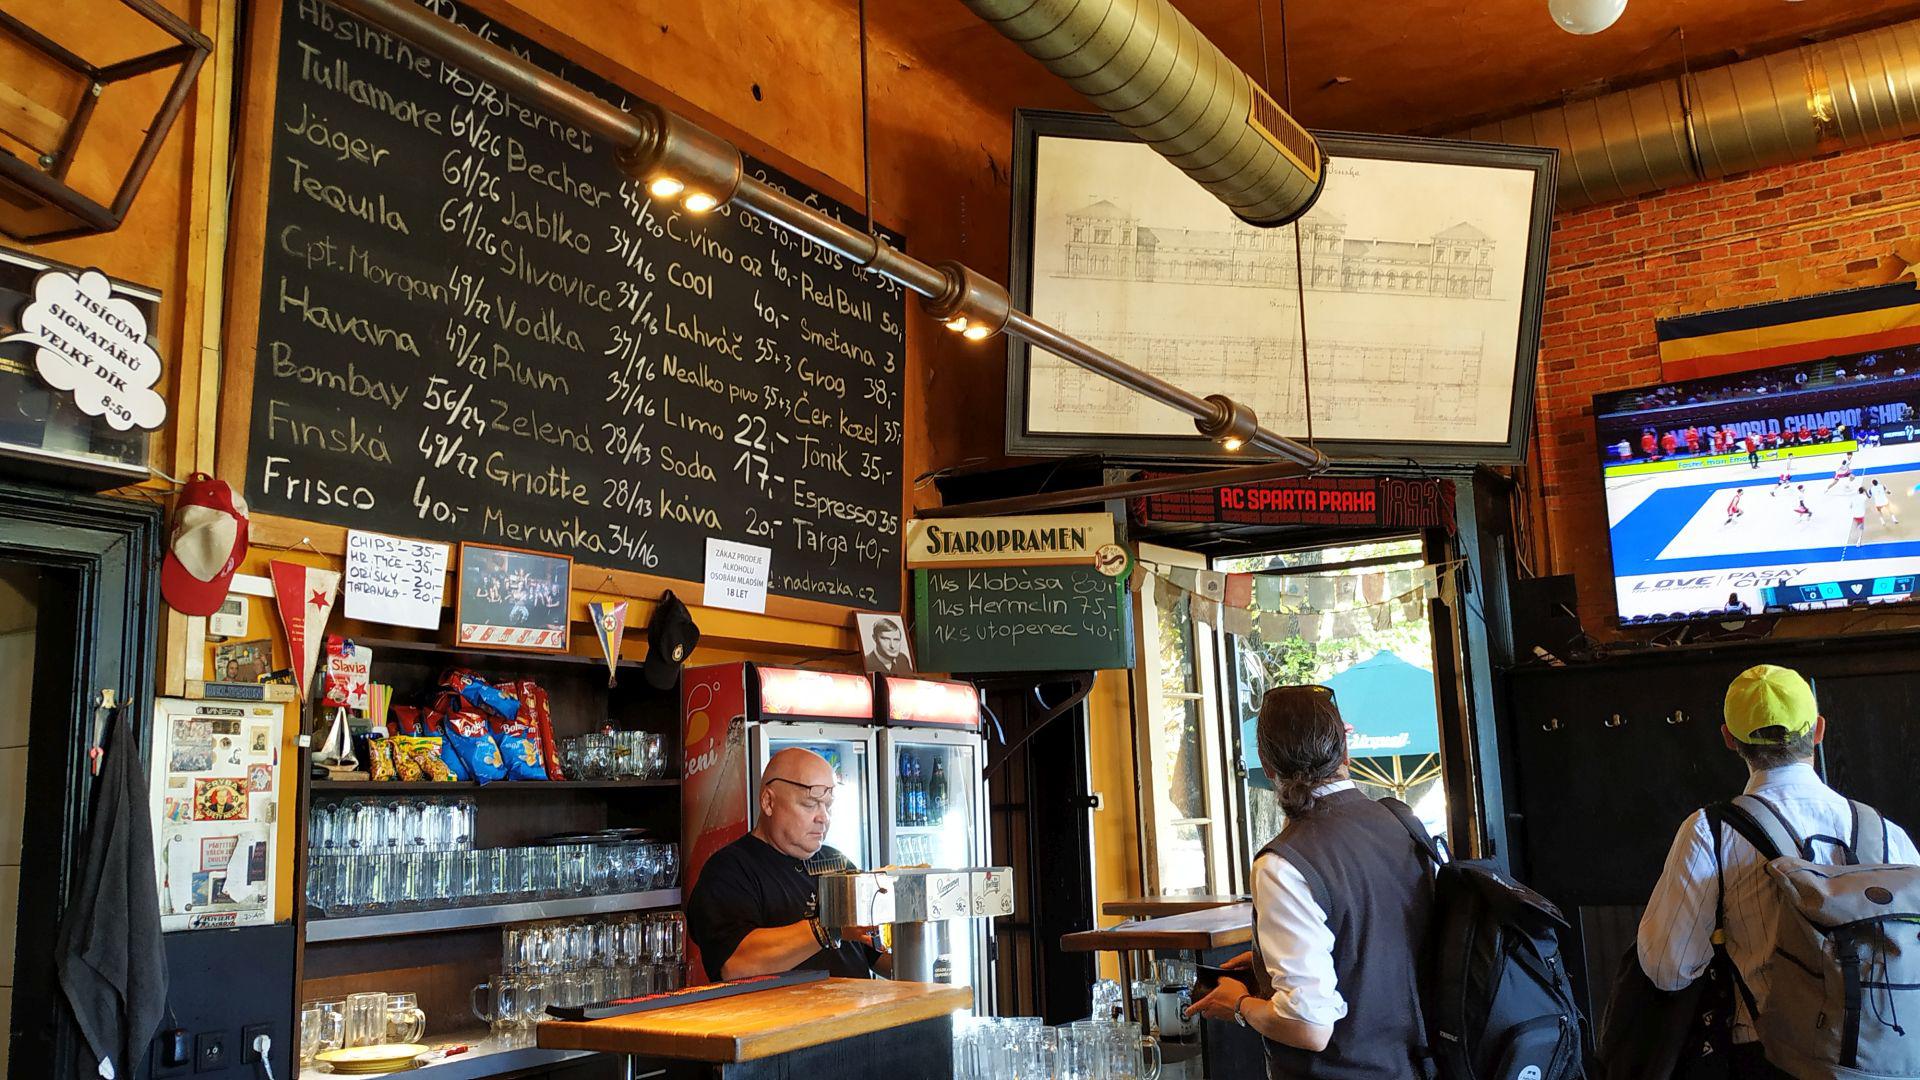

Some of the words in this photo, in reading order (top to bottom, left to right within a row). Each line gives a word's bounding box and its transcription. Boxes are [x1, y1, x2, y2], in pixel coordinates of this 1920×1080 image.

[297, 40, 443, 135] Tullamore
[450, 105, 500, 157] 61/26
[285, 103, 390, 167] Jäger
[442, 149, 500, 202] 61/26
[507, 137, 611, 208] Becher
[439, 198, 497, 256] 61/26
[501, 191, 591, 254] Jablko
[606, 225, 656, 282] 34/16
[448, 265, 491, 324] 49/22
[500, 240, 613, 312] Slivovice
[616, 281, 658, 335] 34/16
[48, 303, 141, 371] SIGNATÁŘŮ
[278, 275, 420, 357] Havana
[446, 318, 487, 379] 49/22
[496, 295, 585, 352] Vodka
[604, 325, 656, 381] 34/16
[664, 303, 744, 361] Lahváč
[800, 318, 877, 368] Smetana
[40, 325, 95, 368] VELKÝ
[94, 364, 128, 392] DÍK
[493, 343, 569, 396] Rum
[606, 371, 656, 416] 34/16
[662, 353, 724, 395] Nealko
[729, 383, 758, 404] pivo
[798, 357, 847, 398] Grog
[101, 395, 132, 422] 8:50
[269, 341, 409, 411] Bombay
[423, 374, 486, 437] 56/24
[268, 399, 392, 464] Finská
[418, 426, 479, 479] 49/22
[489, 398, 594, 454] Zelená
[601, 423, 651, 465] 28/13
[663, 397, 724, 441] Limo
[733, 413, 790, 454] 22,-
[485, 451, 590, 506] Griotte
[602, 478, 653, 518] 28/13
[660, 446, 717, 483] Soda
[796, 433, 853, 478] Tonik
[861, 452, 893, 485] 35,-
[413, 476, 469, 524] 40,-
[745, 508, 784, 541] 20,-
[793, 479, 878, 528] Espresso
[1220, 487, 1244, 509] AC
[1247, 488, 1316, 511] SPARTA
[1319, 491, 1376, 512] PRAHA
[483, 505, 606, 553] Meruňka
[607, 524, 659, 568] 34/16
[792, 517, 848, 567] Targa
[854, 532, 891, 569] 40,-
[926, 525, 1087, 556] STAROPRAMEN
[347, 581, 399, 598] TATRANKA
[723, 562, 755, 575] ALKOHOLU
[727, 588, 735, 597] 18
[736, 589, 749, 599] LET
[1632, 575, 1716, 592] LOVE
[1727, 567, 1809, 581] PASAY
[332, 659, 367, 674] Slavia
